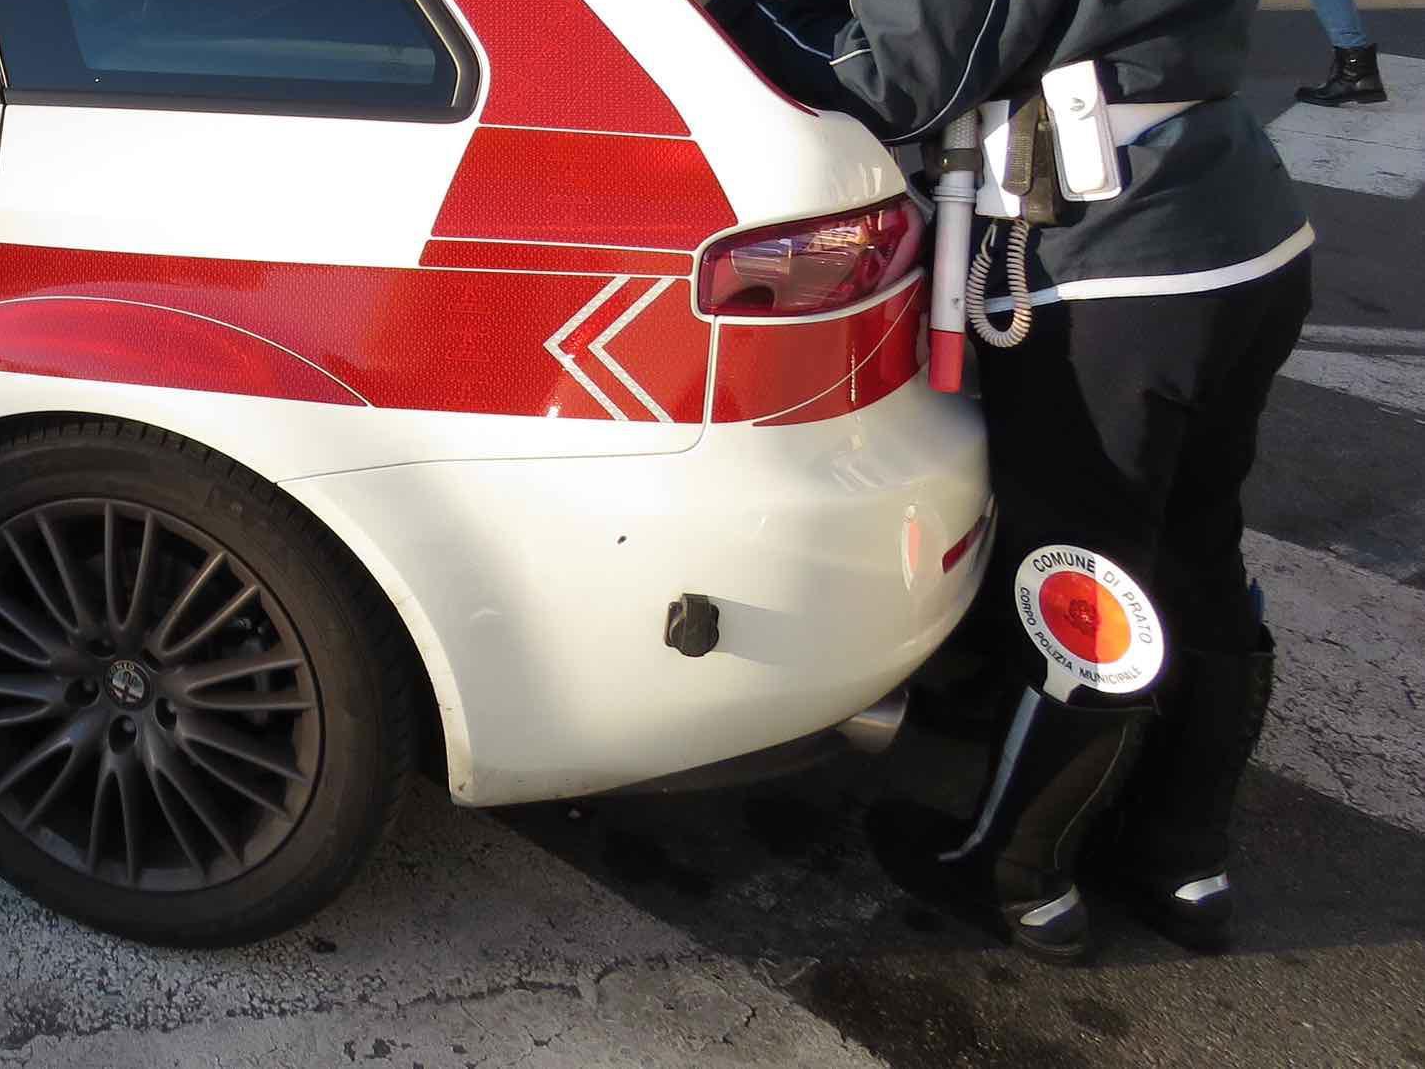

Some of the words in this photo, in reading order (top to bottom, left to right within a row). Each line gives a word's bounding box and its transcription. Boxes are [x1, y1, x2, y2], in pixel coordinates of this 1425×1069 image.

[1019, 586, 1036, 627] CORPO
[1033, 630, 1073, 672] POLIZIA
[1078, 664, 1143, 684] MUNICIPALE
[1032, 550, 1097, 574] COMUNE
[1103, 570, 1120, 588] DI
[1121, 590, 1153, 645] PRATO
